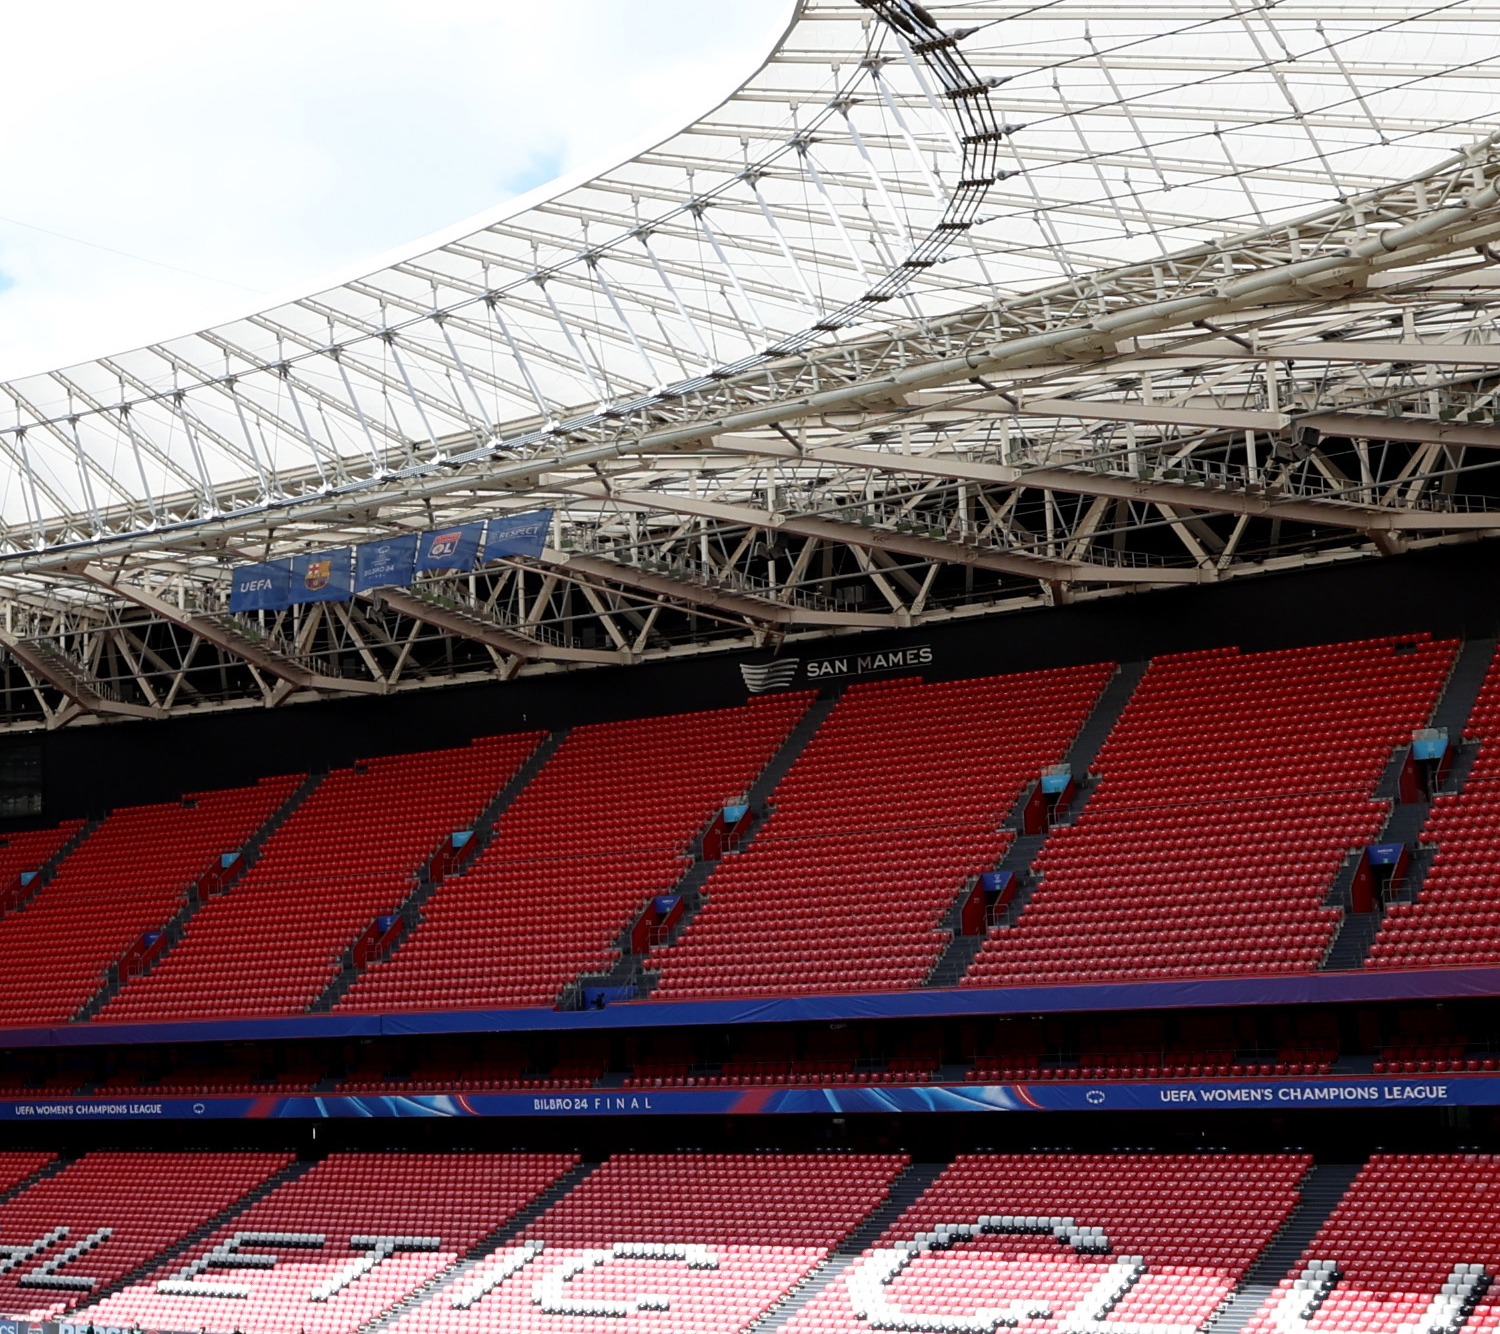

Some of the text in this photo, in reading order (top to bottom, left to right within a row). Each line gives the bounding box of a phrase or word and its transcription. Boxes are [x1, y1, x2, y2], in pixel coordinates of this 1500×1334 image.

[499, 527, 538, 539] RESPECT
[241, 579, 272, 593] UEFA
[807, 648, 933, 677] SAN MAMES
[1160, 1086, 1447, 1102] UEFA WOMEN'S CHAMPIONS LEAGUE
[15, 1104, 162, 1115] UEFA WOMEN'S CHAMPIONS LEAGUE
[534, 1097, 652, 1110] BILBAO 24 FINAL
